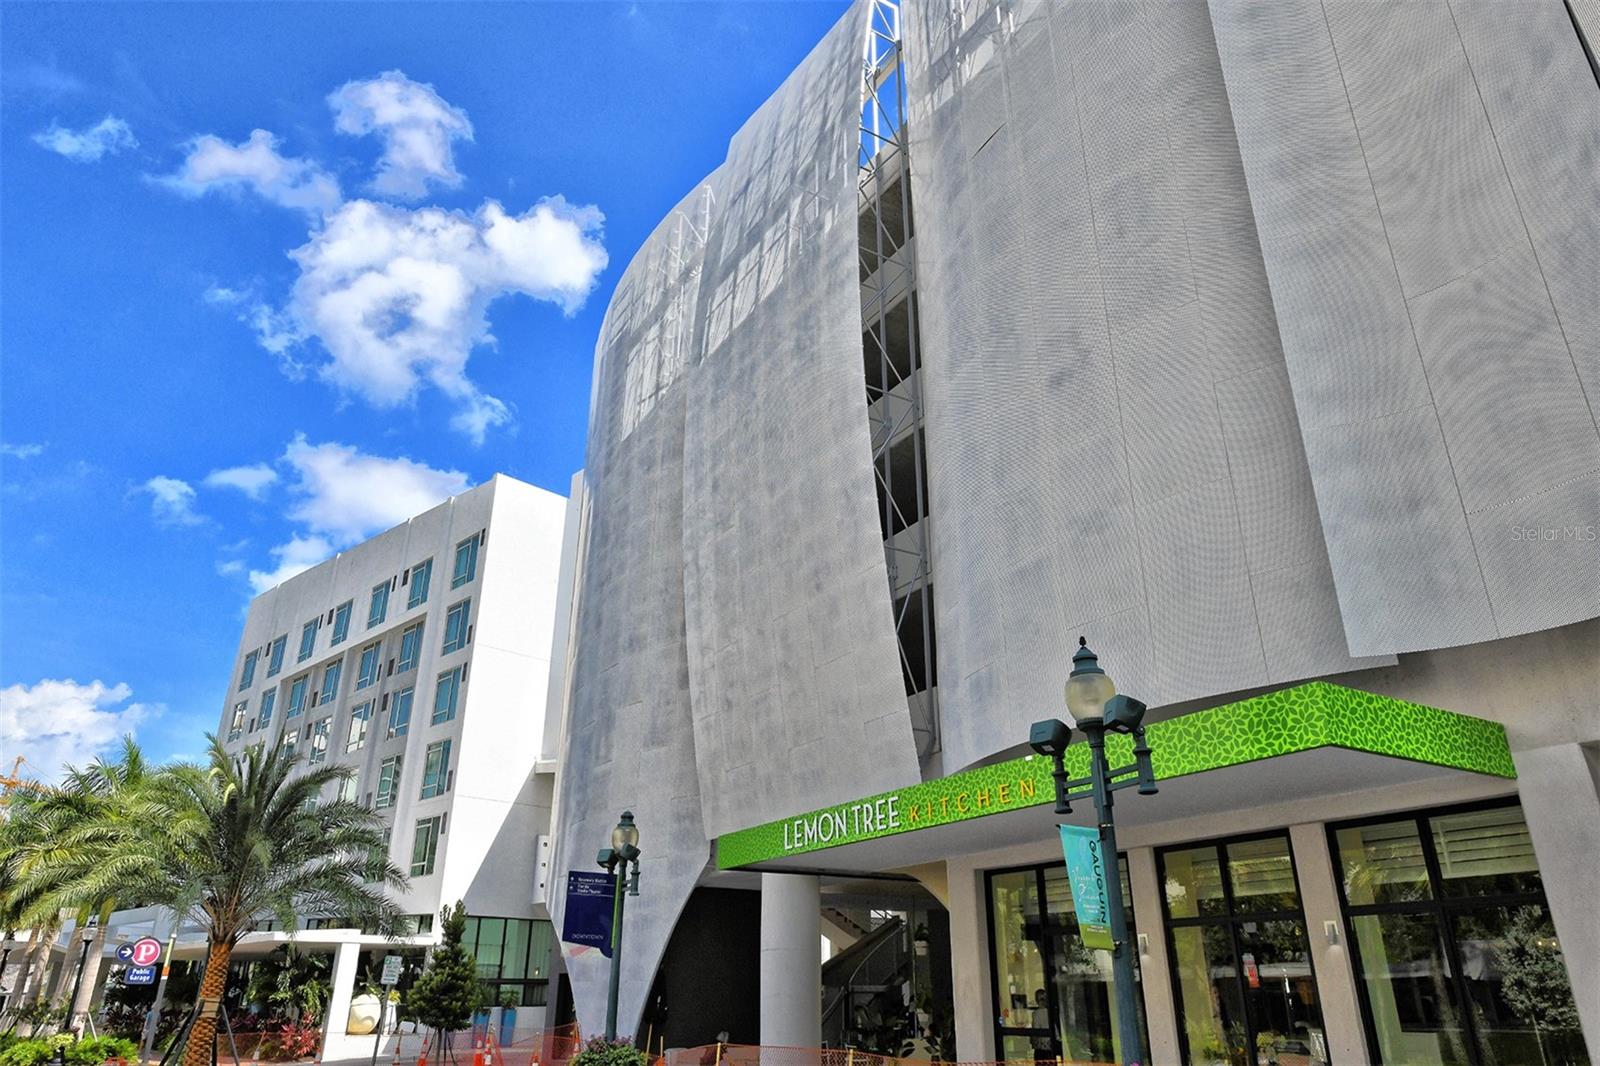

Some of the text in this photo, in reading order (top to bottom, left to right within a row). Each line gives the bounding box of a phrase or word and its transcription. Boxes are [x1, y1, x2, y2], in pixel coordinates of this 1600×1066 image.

[783, 778, 1036, 851] LEMON TREE KITCHEN
[137, 944, 156, 962] P
[129, 974, 151, 983] Garage
